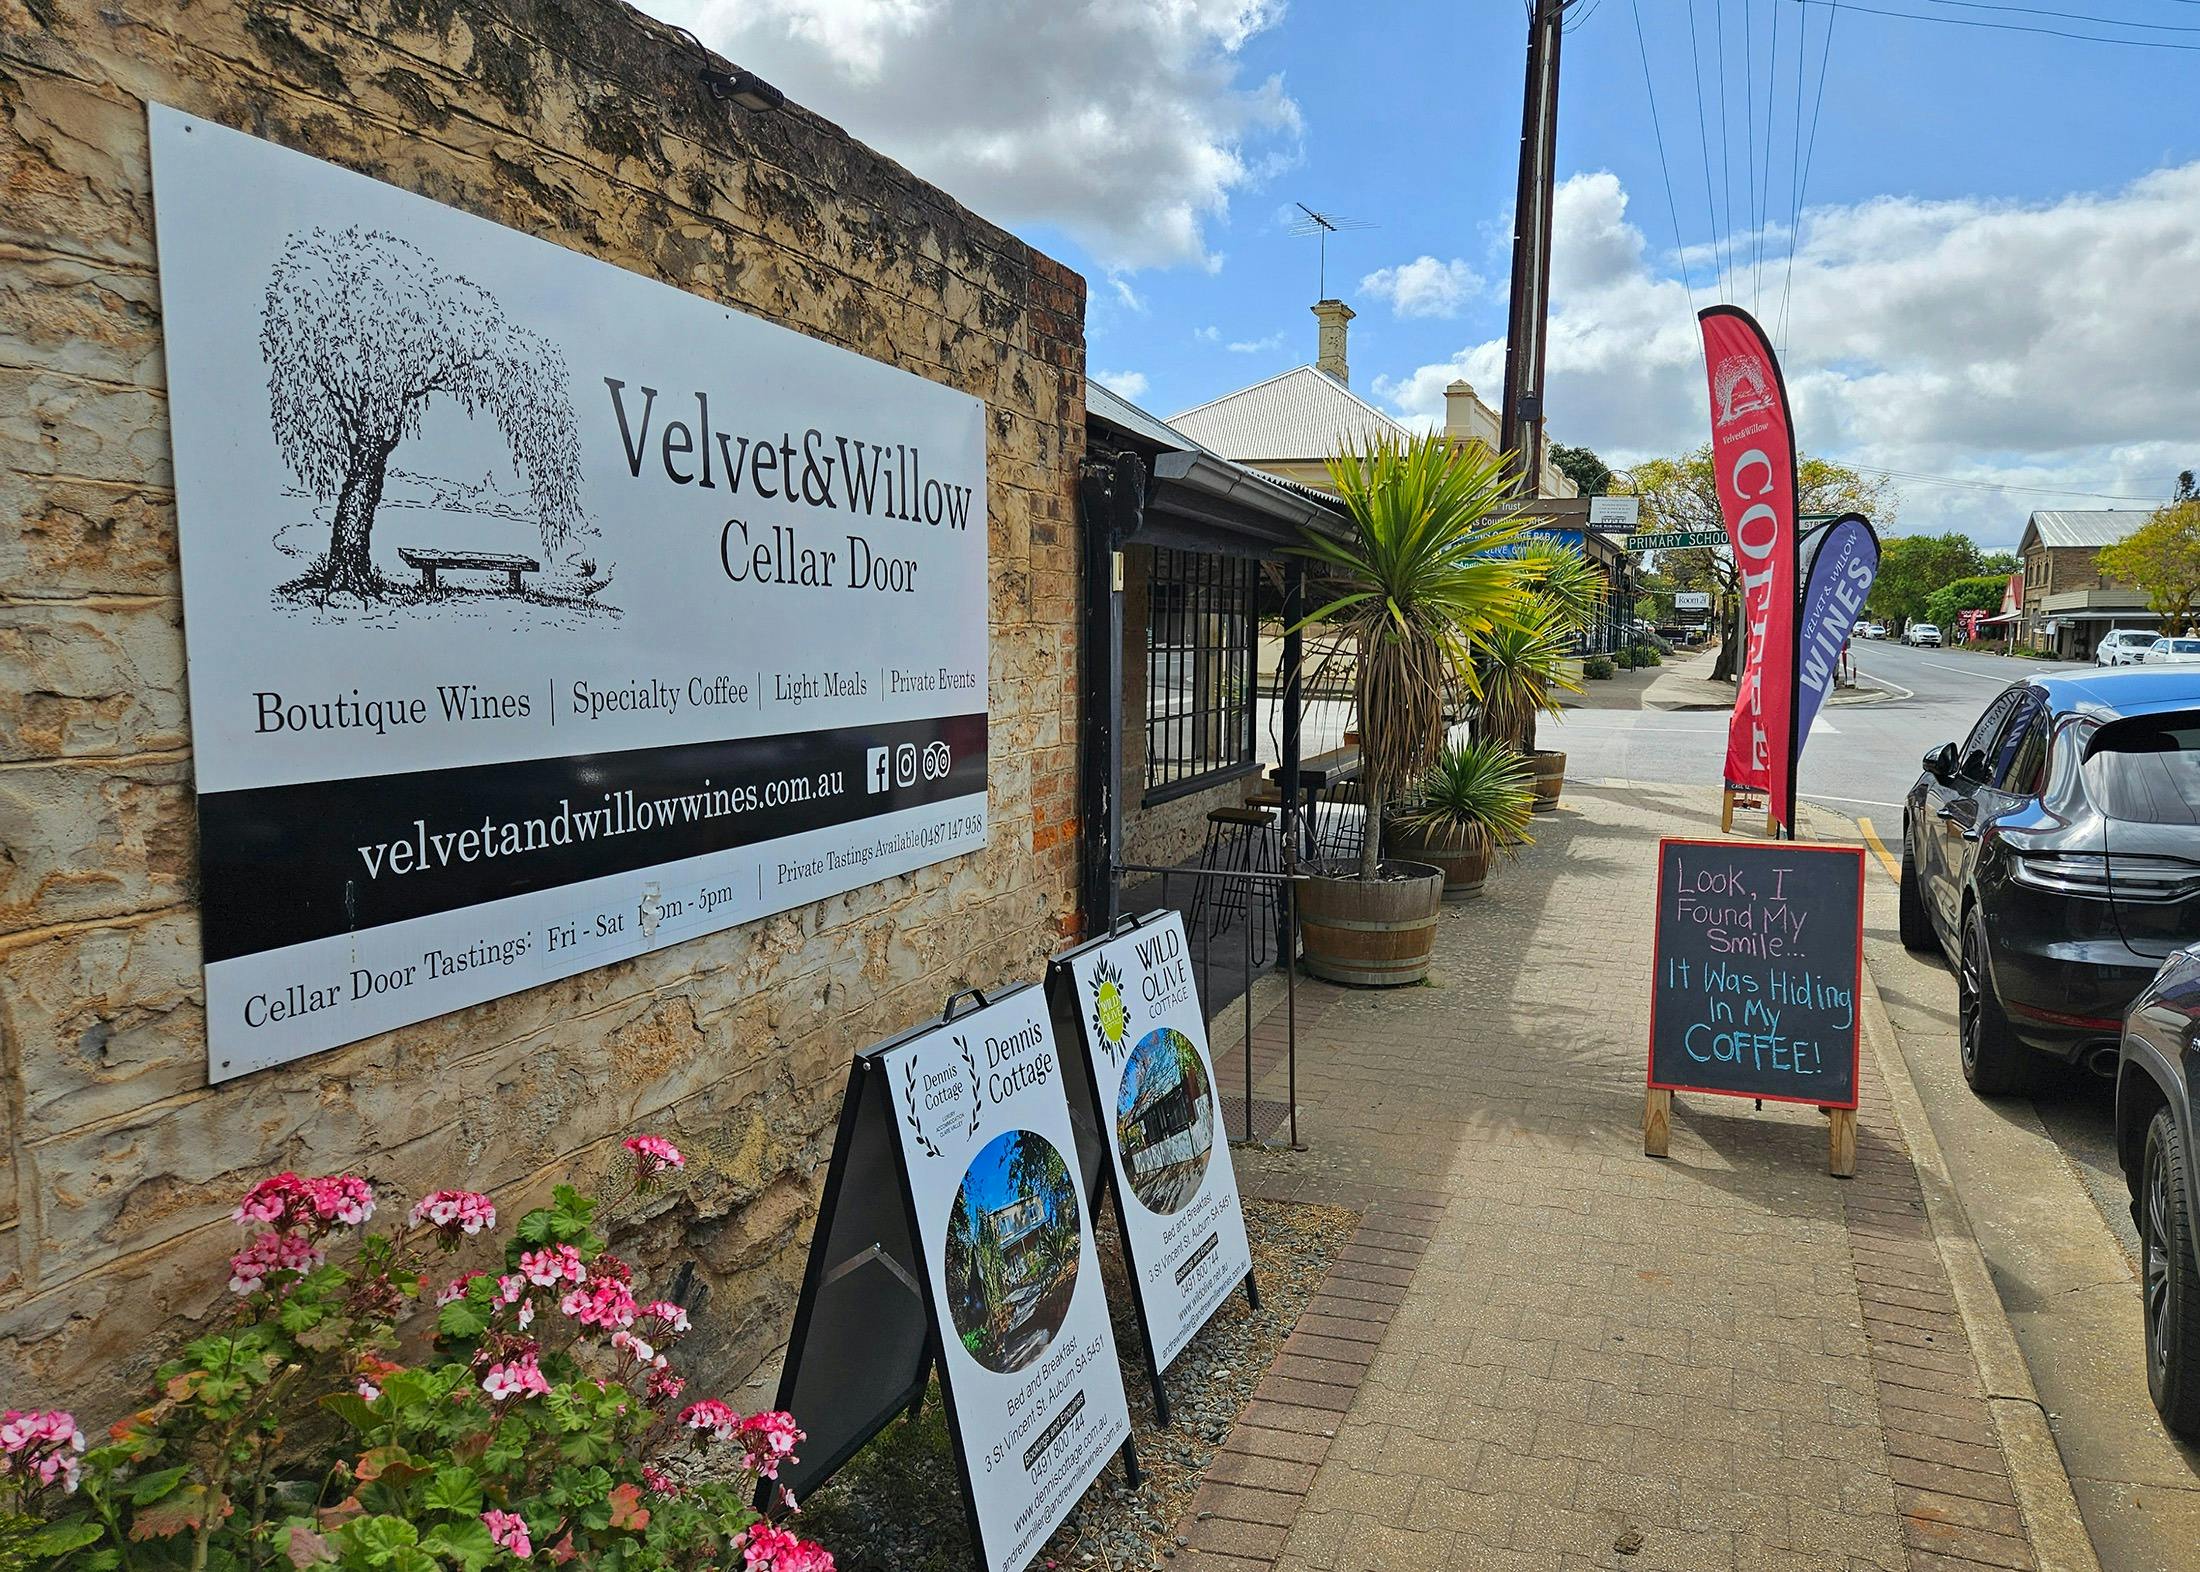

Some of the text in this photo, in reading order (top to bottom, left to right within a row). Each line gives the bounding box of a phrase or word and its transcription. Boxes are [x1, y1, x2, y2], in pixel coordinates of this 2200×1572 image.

[603, 376, 972, 531] Velvet&Willow
[1722, 422, 1769, 445] Velvet&Willow
[1502, 502, 1521, 510] Trust
[720, 518, 917, 593] Cellar Door
[1629, 532, 1729, 549] PRIMARY SCHOO
[1803, 529, 1858, 640] VELVET & WILLOW
[1800, 556, 1874, 693] WINES
[253, 668, 976, 735] Boutique Wines Specialty Coffee Light Meals Private Events
[357, 770, 845, 881] velvetandwillowwines.com.au
[777, 814, 983, 885] Private Tastings Available 0487 147 958
[1677, 857, 1793, 901] Look, I
[1677, 898, 1807, 943] Found My
[244, 984, 341, 1028] Cellar
[350, 965, 417, 1001] Door
[424, 931, 532, 980] Tastings:
[547, 921, 577, 952] Fri
[596, 912, 625, 938] Sat
[637, 901, 683, 928] 1pm
[698, 885, 733, 913] 5pm
[1135, 929, 1179, 971] WILD
[1100, 995, 1119, 1013] WILD
[1142, 959, 1187, 1002] OLIVE
[1149, 986, 1189, 1019] COTTAGE
[1669, 957, 1853, 1029] It Was Hiding
[1103, 1007, 1122, 1025] OLIVE
[1709, 996, 1781, 1043] In My
[984, 1018, 1043, 1069] Dennis
[1685, 1023, 1822, 1074] COFFEE!
[922, 1063, 958, 1092] Dennis
[924, 1082, 964, 1111] Cottage
[988, 1053, 1054, 1104] Cottage
[1154, 1260, 1163, 1278] St
[1161, 1241, 1184, 1269] Vincent
[1192, 1217, 1211, 1240] Auburn
[1210, 1207, 1220, 1222] SA
[1162, 1191, 1213, 1245] Bed and Breakfast
[1180, 1272, 1196, 1298] 0491
[1006, 1335, 1078, 1417] Bed and Breakfast
[985, 1333, 1105, 1473] 3 St Vincent St. Auburn SA 5451
[1024, 1432, 1051, 1466] Bookings
[1049, 1418, 1061, 1437] and
[1031, 1411, 1085, 1485] 0491 800 744
[1001, 1417, 1124, 1572] andrewmiller@andrewmillerwines.com.au
[1013, 1413, 1108, 1534] www.denniscottage.com.au
